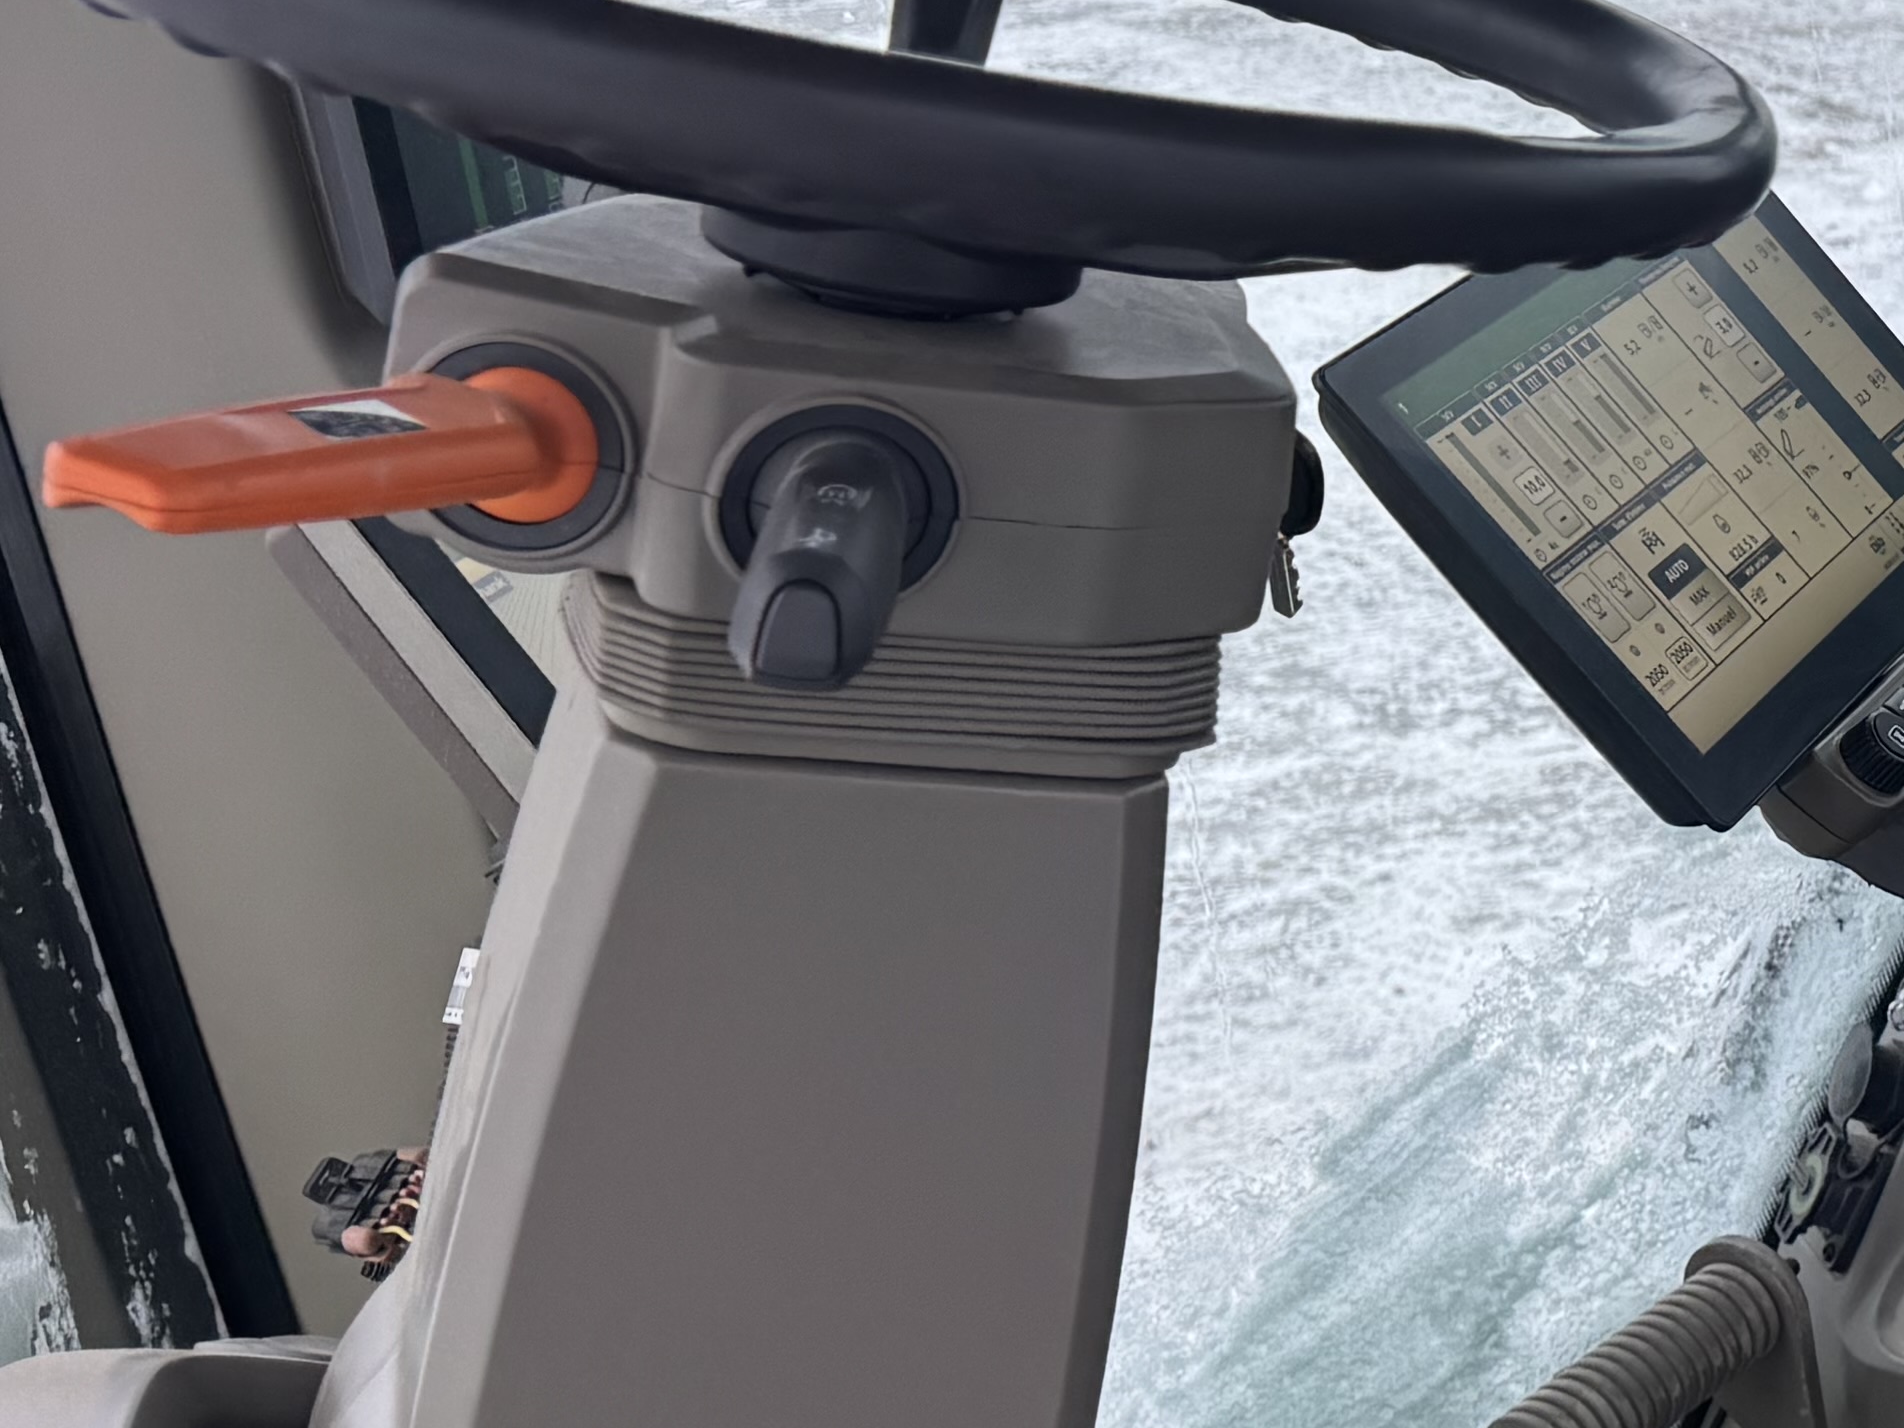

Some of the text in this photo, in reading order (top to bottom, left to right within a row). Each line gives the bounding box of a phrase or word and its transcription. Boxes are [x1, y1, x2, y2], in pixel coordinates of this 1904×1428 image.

[1580, 339, 1594, 352] V
[1551, 358, 1568, 373] IV
[1522, 475, 1546, 496] 10,0
[1663, 558, 1690, 584] AUTO
[1688, 585, 1711, 607] MAX
[1706, 605, 1738, 637] Manuel
[1669, 641, 1694, 665] 2050
[1644, 663, 1670, 687] 2050
